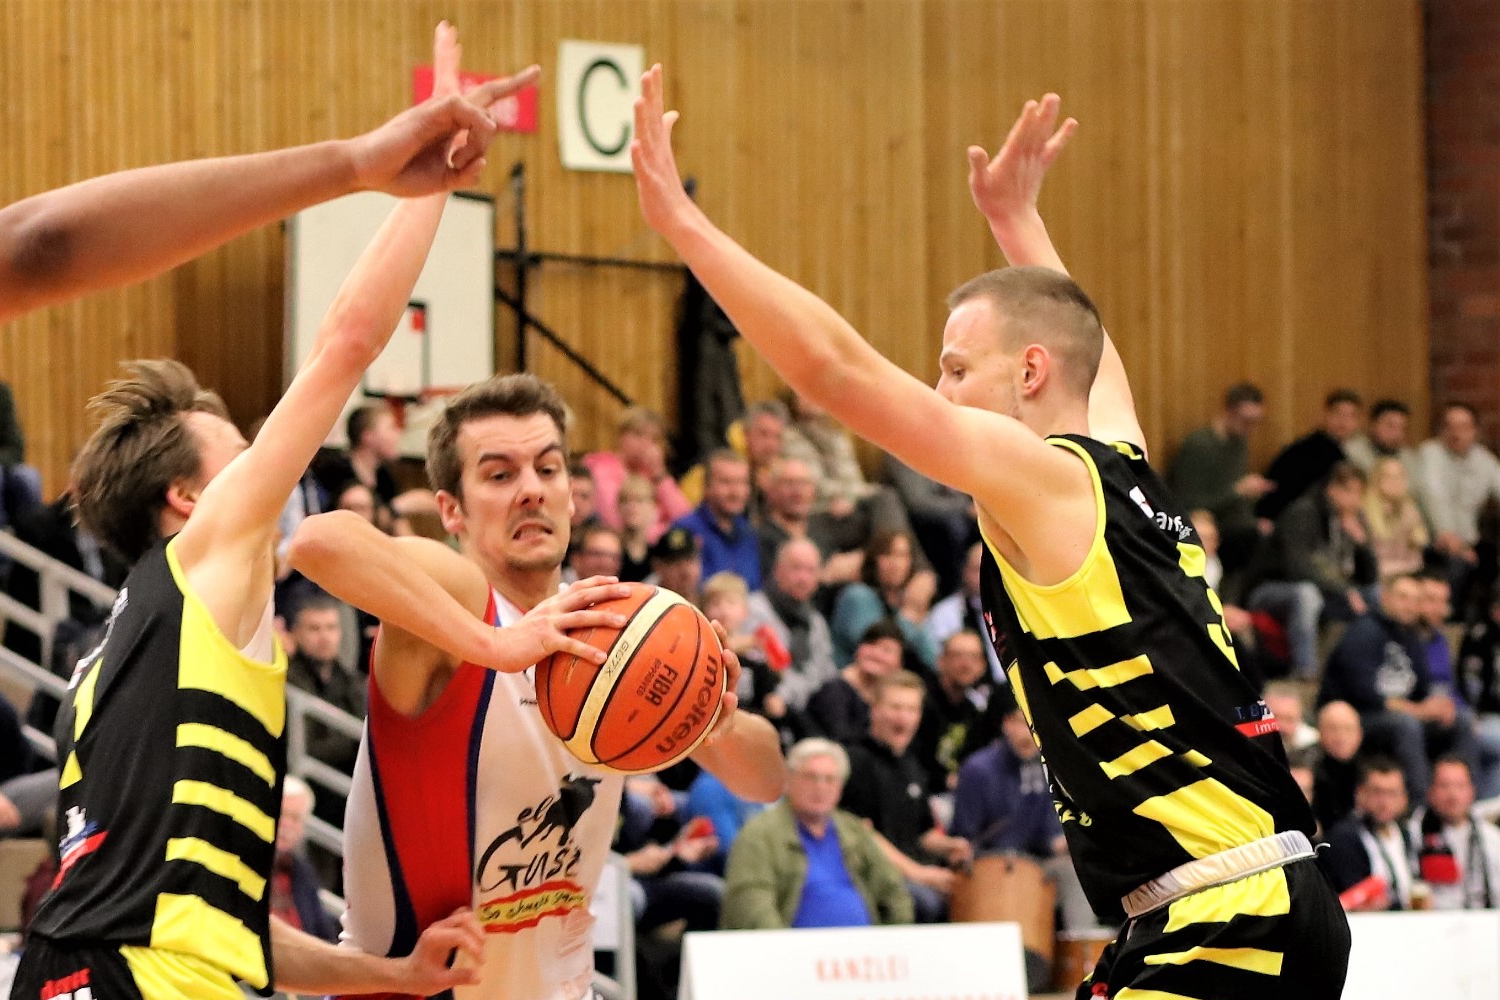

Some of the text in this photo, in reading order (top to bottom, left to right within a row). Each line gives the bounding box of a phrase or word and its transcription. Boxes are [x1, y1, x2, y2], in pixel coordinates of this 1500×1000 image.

[577, 55, 631, 157] C
[644, 664, 679, 707] FIBA
[656, 653, 719, 755] molten
